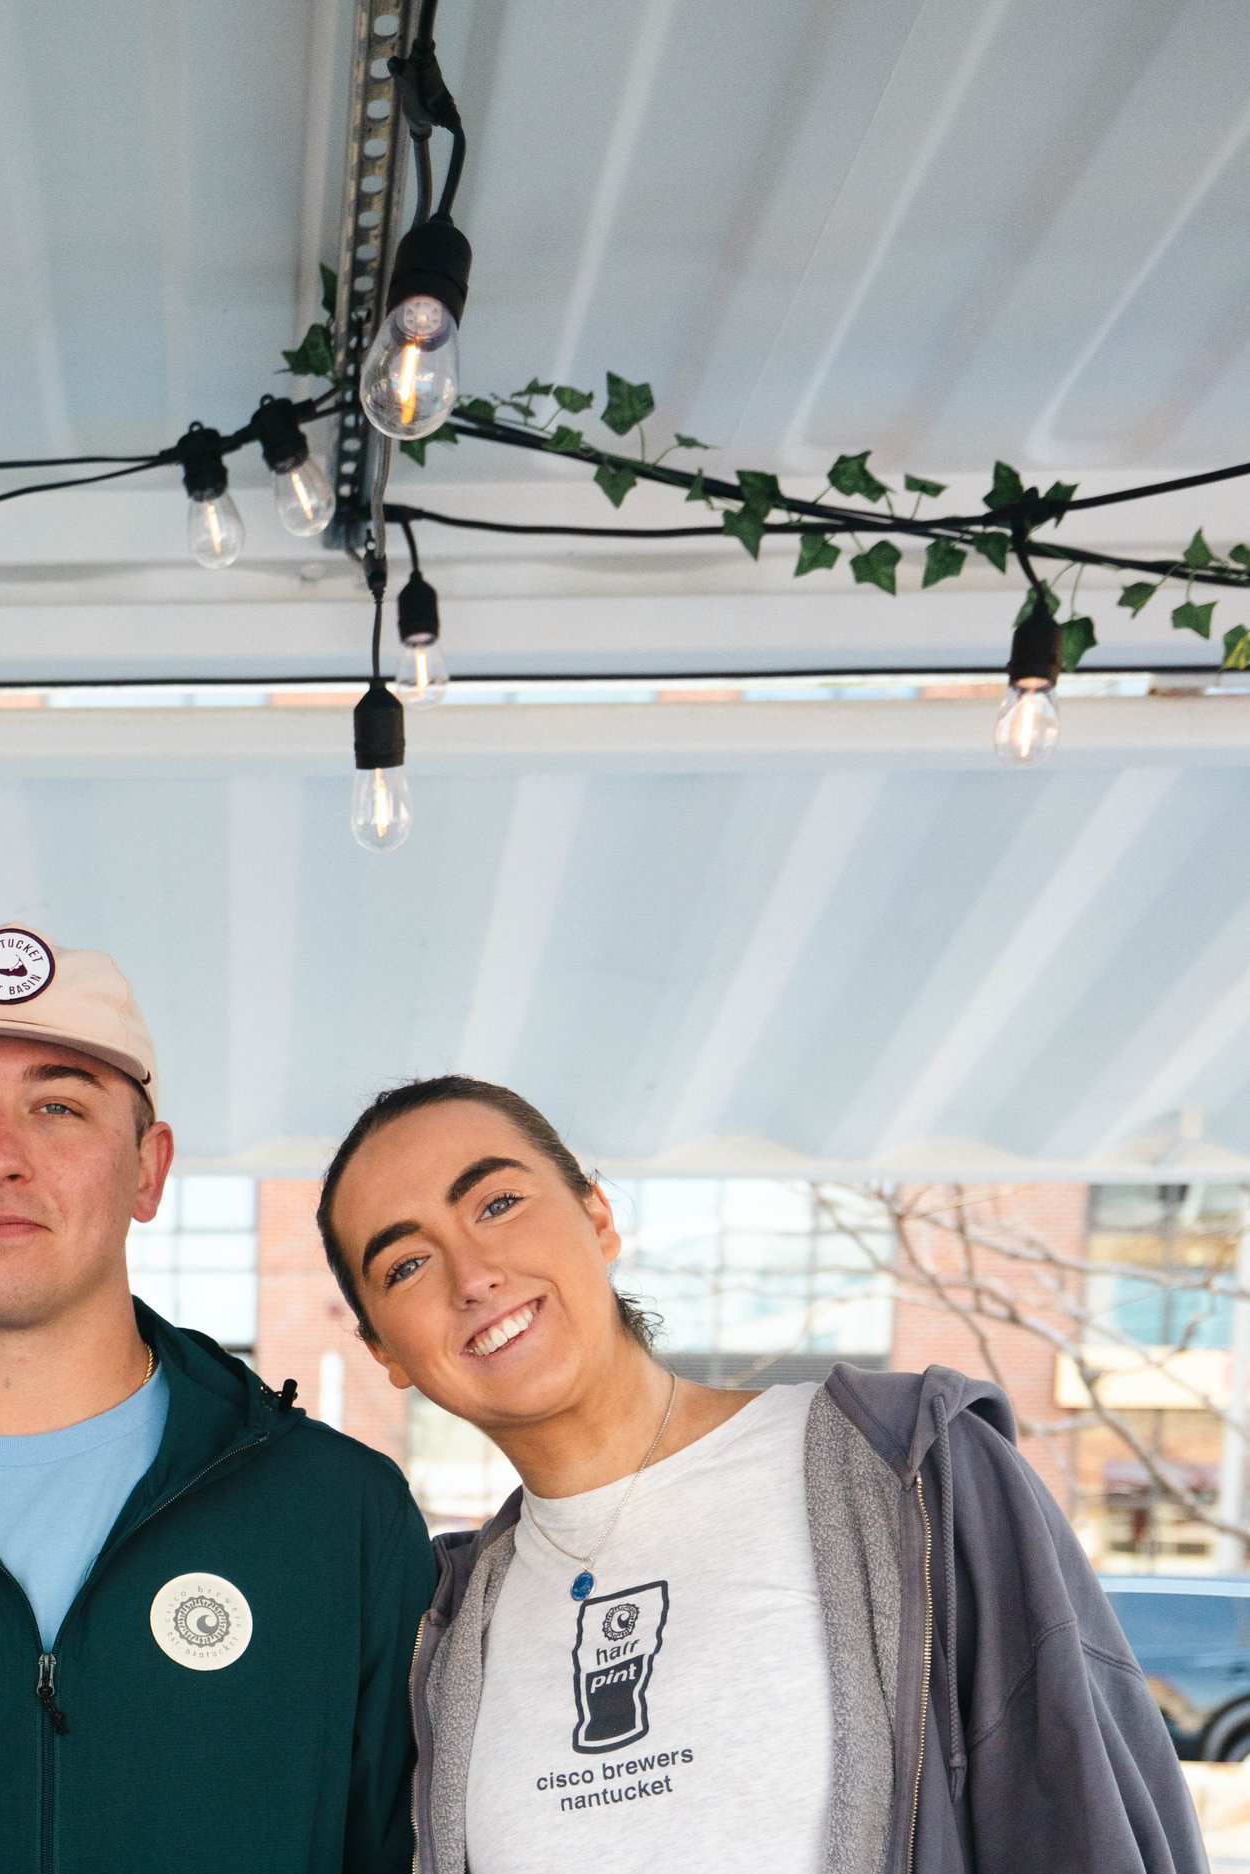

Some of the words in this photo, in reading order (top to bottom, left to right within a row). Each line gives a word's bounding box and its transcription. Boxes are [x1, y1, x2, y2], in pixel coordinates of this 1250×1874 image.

[8, 974, 42, 995] BASIN
[596, 1639, 640, 1666] half
[590, 1663, 637, 1694] pint
[536, 1768, 594, 1791] cisco
[602, 1748, 694, 1781] brewers
[560, 1775, 673, 1811] nantucket
